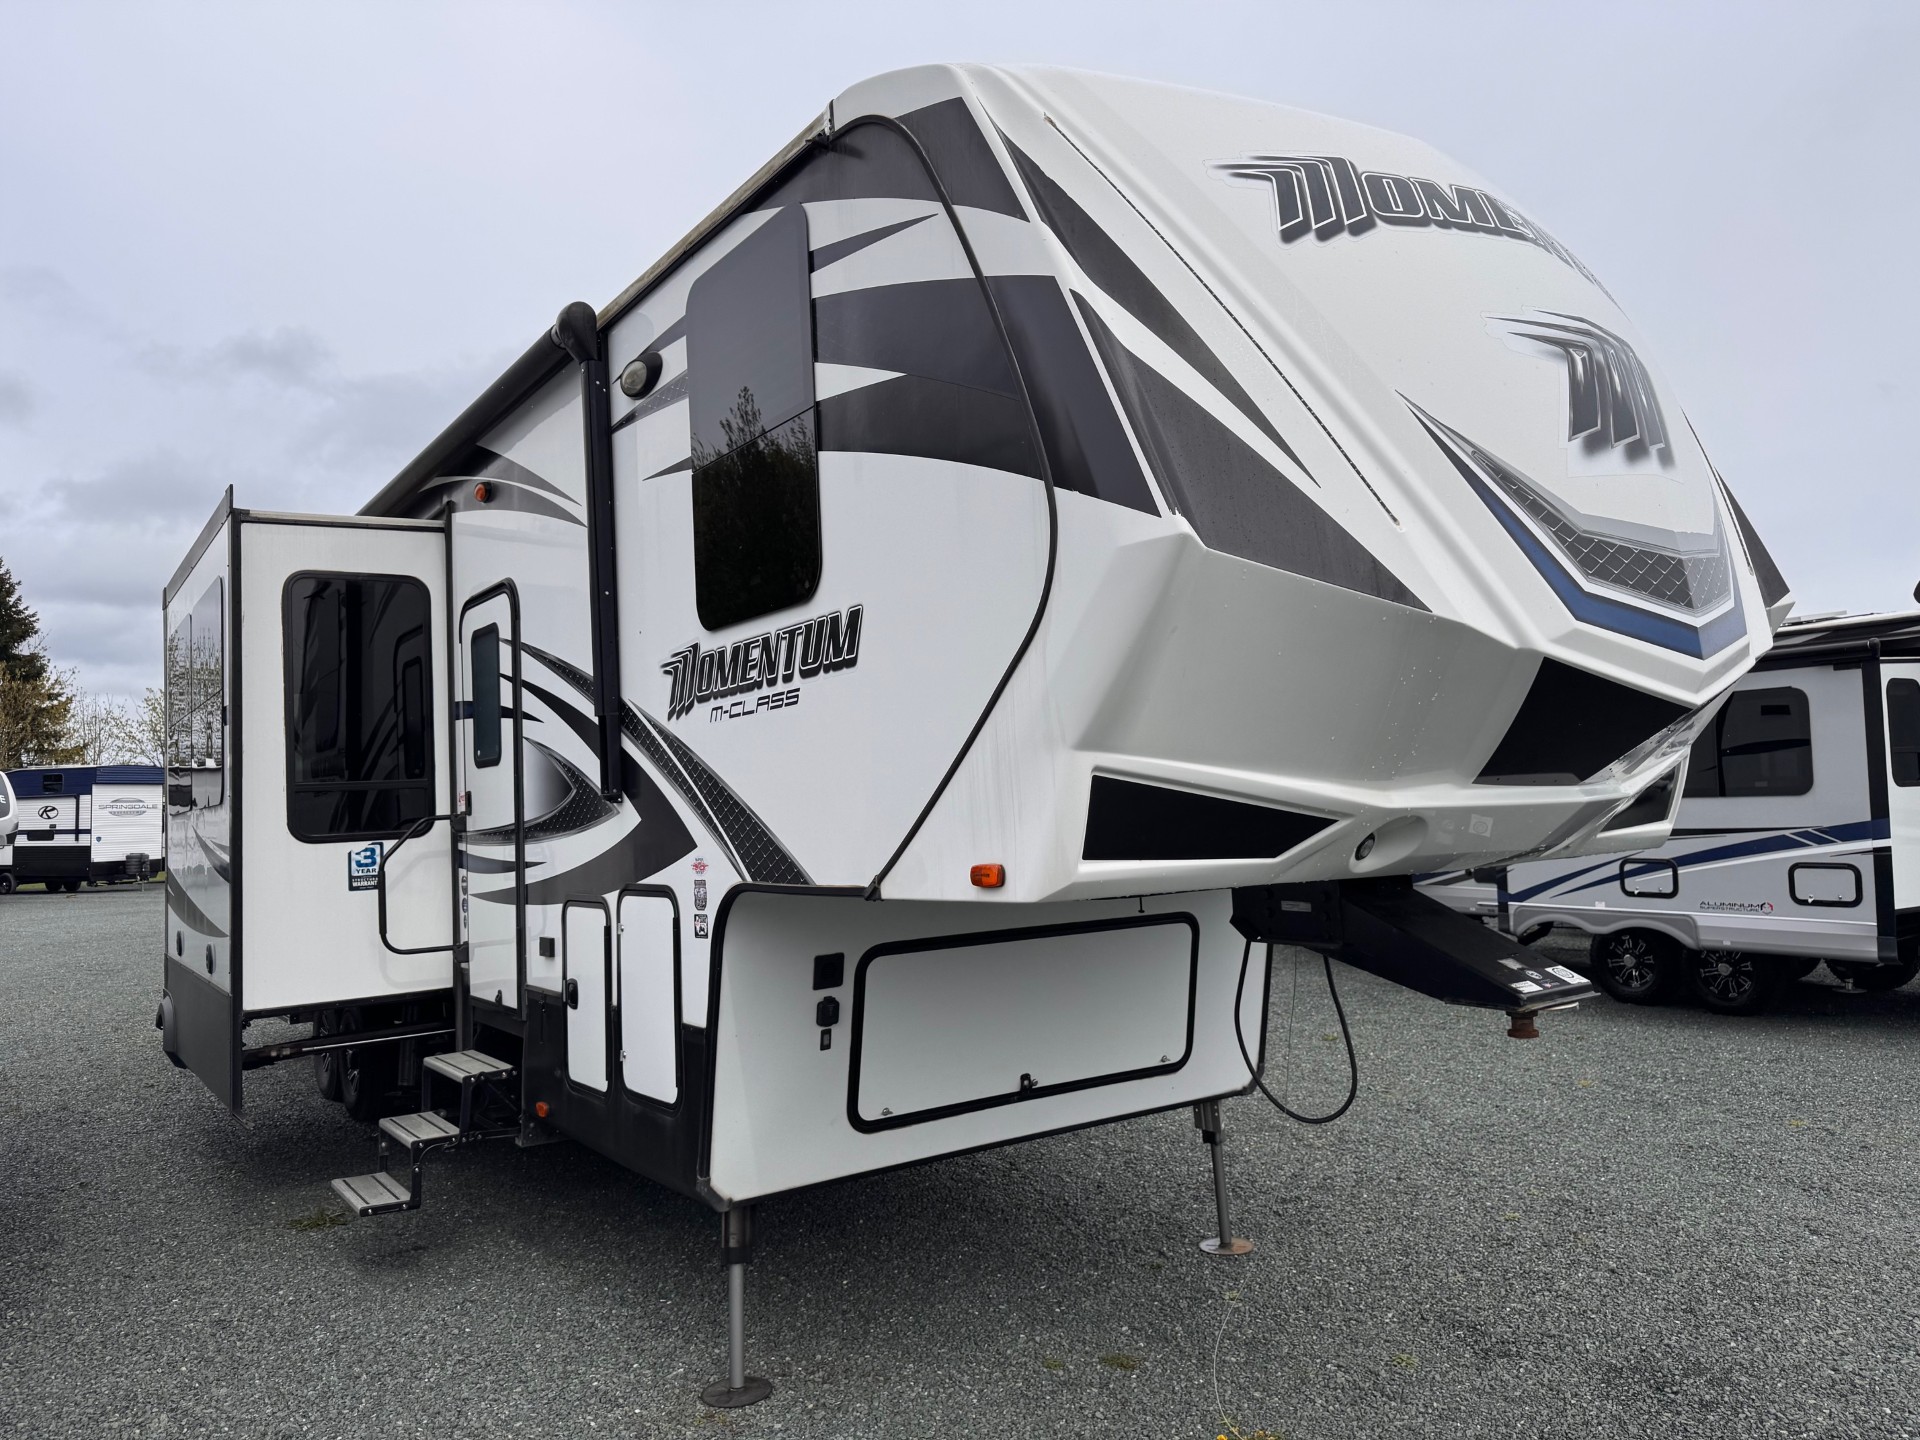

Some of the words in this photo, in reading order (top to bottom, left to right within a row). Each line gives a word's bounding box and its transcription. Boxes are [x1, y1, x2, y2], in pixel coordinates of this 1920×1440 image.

[660, 604, 863, 721] MOMENTUM
[709, 687, 801, 723] M-CLASS
[355, 847, 377, 868] 3
